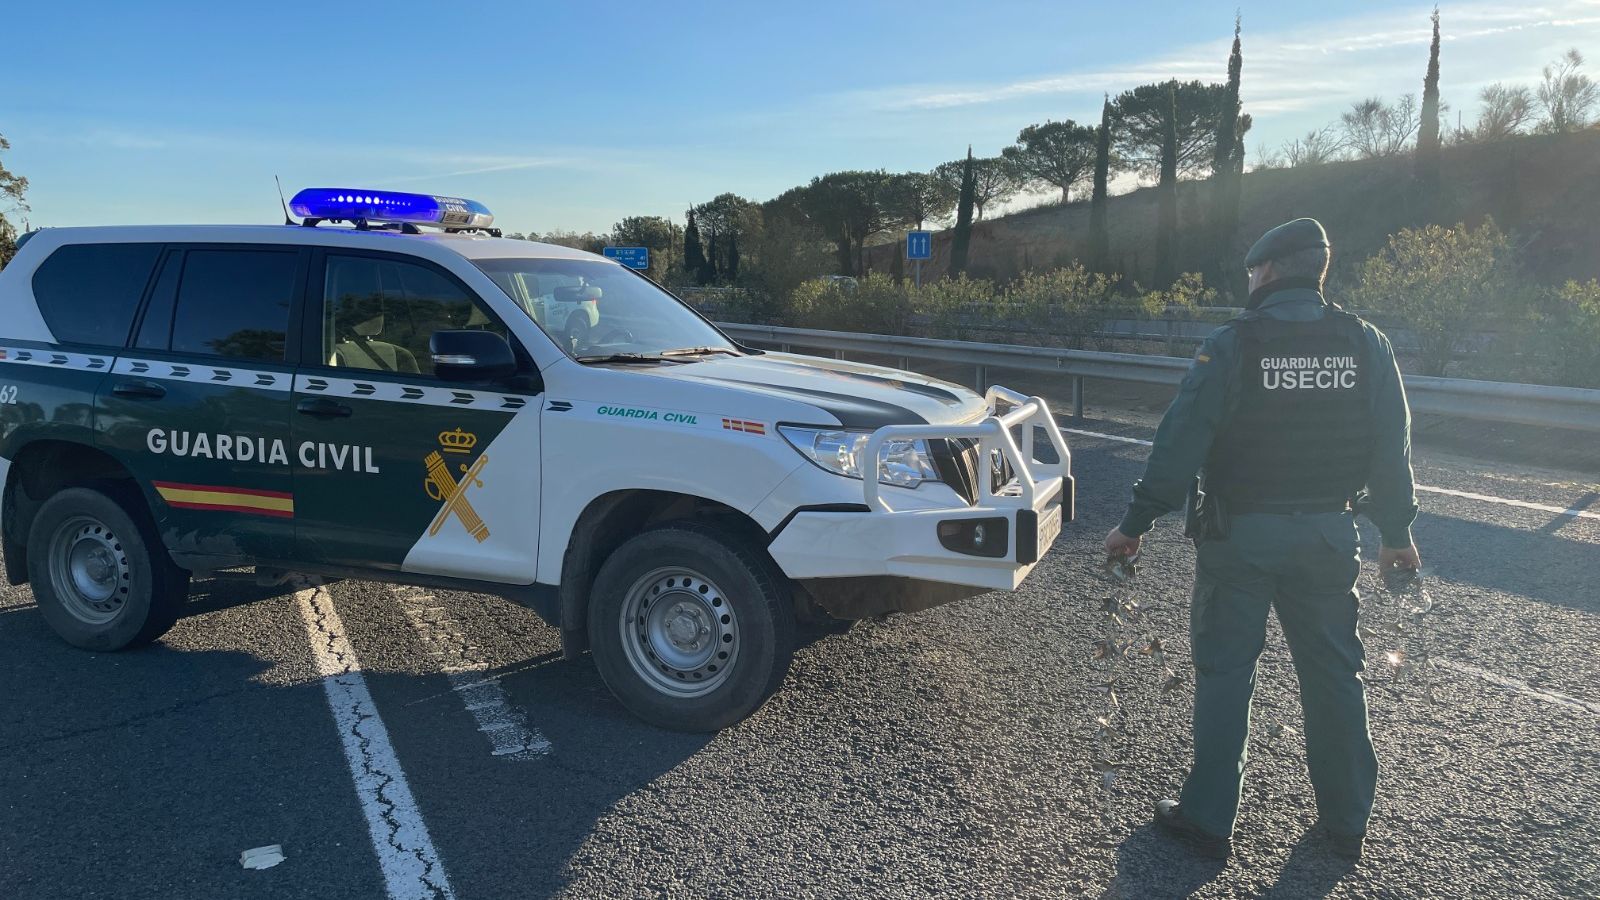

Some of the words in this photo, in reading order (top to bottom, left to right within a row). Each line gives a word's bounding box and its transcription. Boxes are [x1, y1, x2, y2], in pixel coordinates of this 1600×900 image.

[446, 204, 467, 213] CIVIL
[1260, 357, 1320, 370] GUARDIA
[1324, 356, 1357, 369] CIVIL
[1263, 370, 1357, 389] USECIC
[0, 385, 18, 405] 62
[597, 406, 658, 420] GUARDIA
[664, 412, 697, 425] CIVIL
[147, 428, 288, 465] GUARDIA
[299, 441, 379, 474] CIVIL
